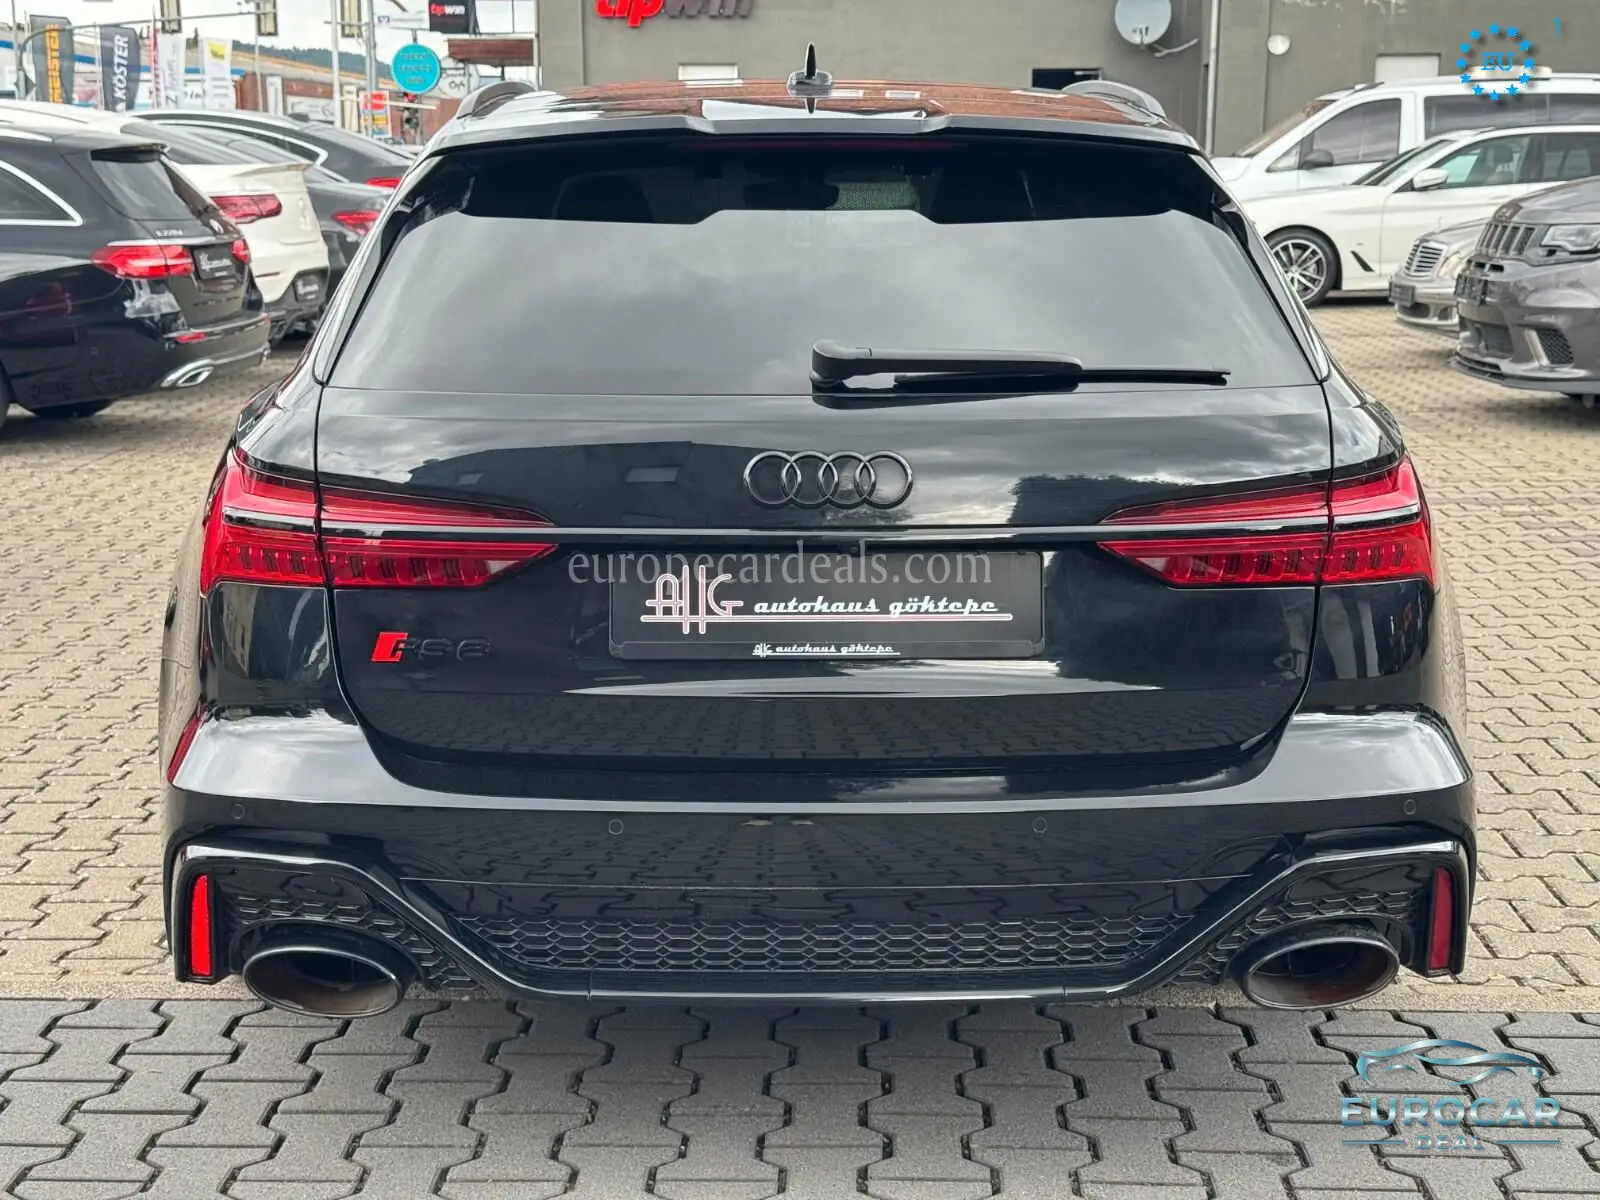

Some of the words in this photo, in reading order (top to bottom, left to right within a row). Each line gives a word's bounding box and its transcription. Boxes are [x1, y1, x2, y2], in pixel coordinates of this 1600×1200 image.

[112, 34, 129, 99] KÖSTER
[754, 596, 879, 614] autohaus
[889, 596, 998, 618] göktepe
[776, 643, 837, 653] autohaus
[841, 643, 895, 655] göktepe
